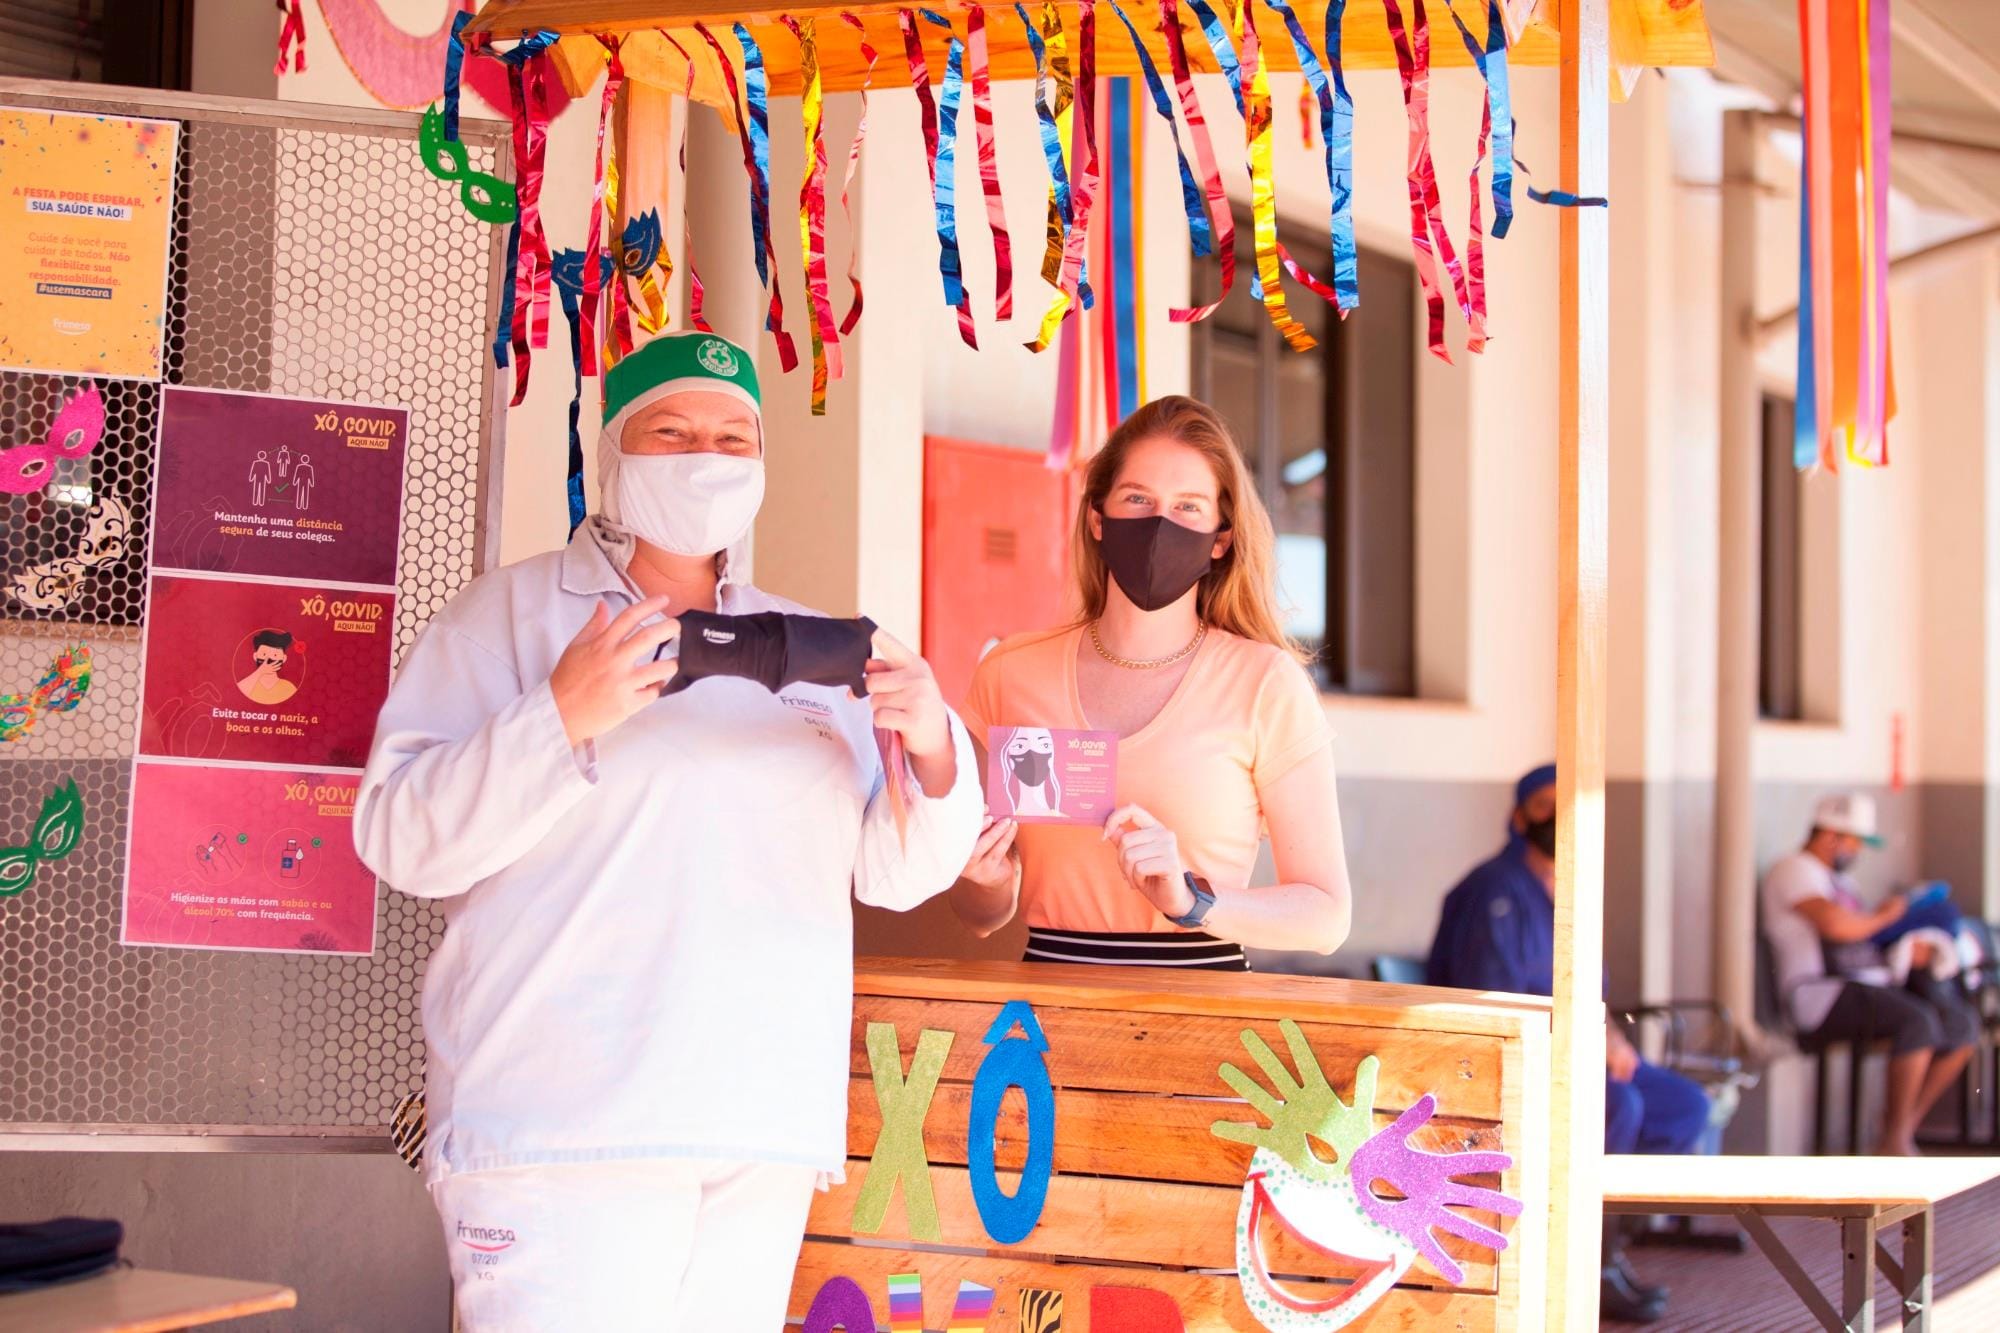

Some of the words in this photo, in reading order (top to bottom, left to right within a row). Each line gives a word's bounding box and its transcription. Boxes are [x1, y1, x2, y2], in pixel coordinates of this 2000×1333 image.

[12, 186, 20, 196] A
[23, 187, 56, 199] FESTA
[59, 191, 90, 203] PODE
[92, 194, 145, 208] ESPERAR,
[32, 201, 54, 212] SUA
[56, 202, 94, 215] SAÚDE
[96, 206, 124, 218] NÃO!
[28, 231, 59, 244] Cuide
[61, 234, 74, 245] de
[77, 235, 101, 247] você
[103, 239, 128, 250] para
[23, 245, 56, 256] cuidar
[60, 246, 72, 257] de
[75, 248, 106, 260] todos.
[108, 251, 131, 262] Não
[40, 258, 91, 271] flexibilize
[93, 264, 112, 273] sua
[28, 271, 121, 286] responsabilidade.
[38, 283, 110, 298] #usemascara
[350, 438, 368, 447] AQUI
[369, 438, 387, 448] NÃO!
[214, 511, 268, 525] Mantenha
[270, 518, 294, 527] uma
[296, 517, 343, 531] distância
[219, 526, 254, 537] segura
[256, 527, 269, 537] de
[271, 530, 294, 539] seus
[295, 531, 336, 544] colegas.
[337, 622, 355, 630] AQUI
[355, 622, 374, 631] NÃO!
[212, 707, 239, 719] Evite
[240, 710, 269, 721] tocar
[270, 713, 278, 721] o
[279, 713, 309, 725] nariz,
[311, 716, 319, 724] a
[226, 721, 251, 733] boca
[252, 725, 260, 733] e
[261, 726, 273, 734] os
[275, 725, 305, 736] olhos.
[320, 806, 339, 815] AQUI
[170, 892, 215, 905] Higienize
[216, 895, 228, 904] as
[230, 895, 257, 906] mãos
[258, 898, 279, 907] com
[281, 897, 311, 909] sabão
[311, 901, 318, 909] e
[319, 901, 333, 909] ou
[184, 906, 213, 917] álcool
[215, 907, 236, 918] 70%
[236, 910, 258, 919] com
[260, 909, 315, 923] frequência.
[851, 1000, 1056, 1245] XÔ
